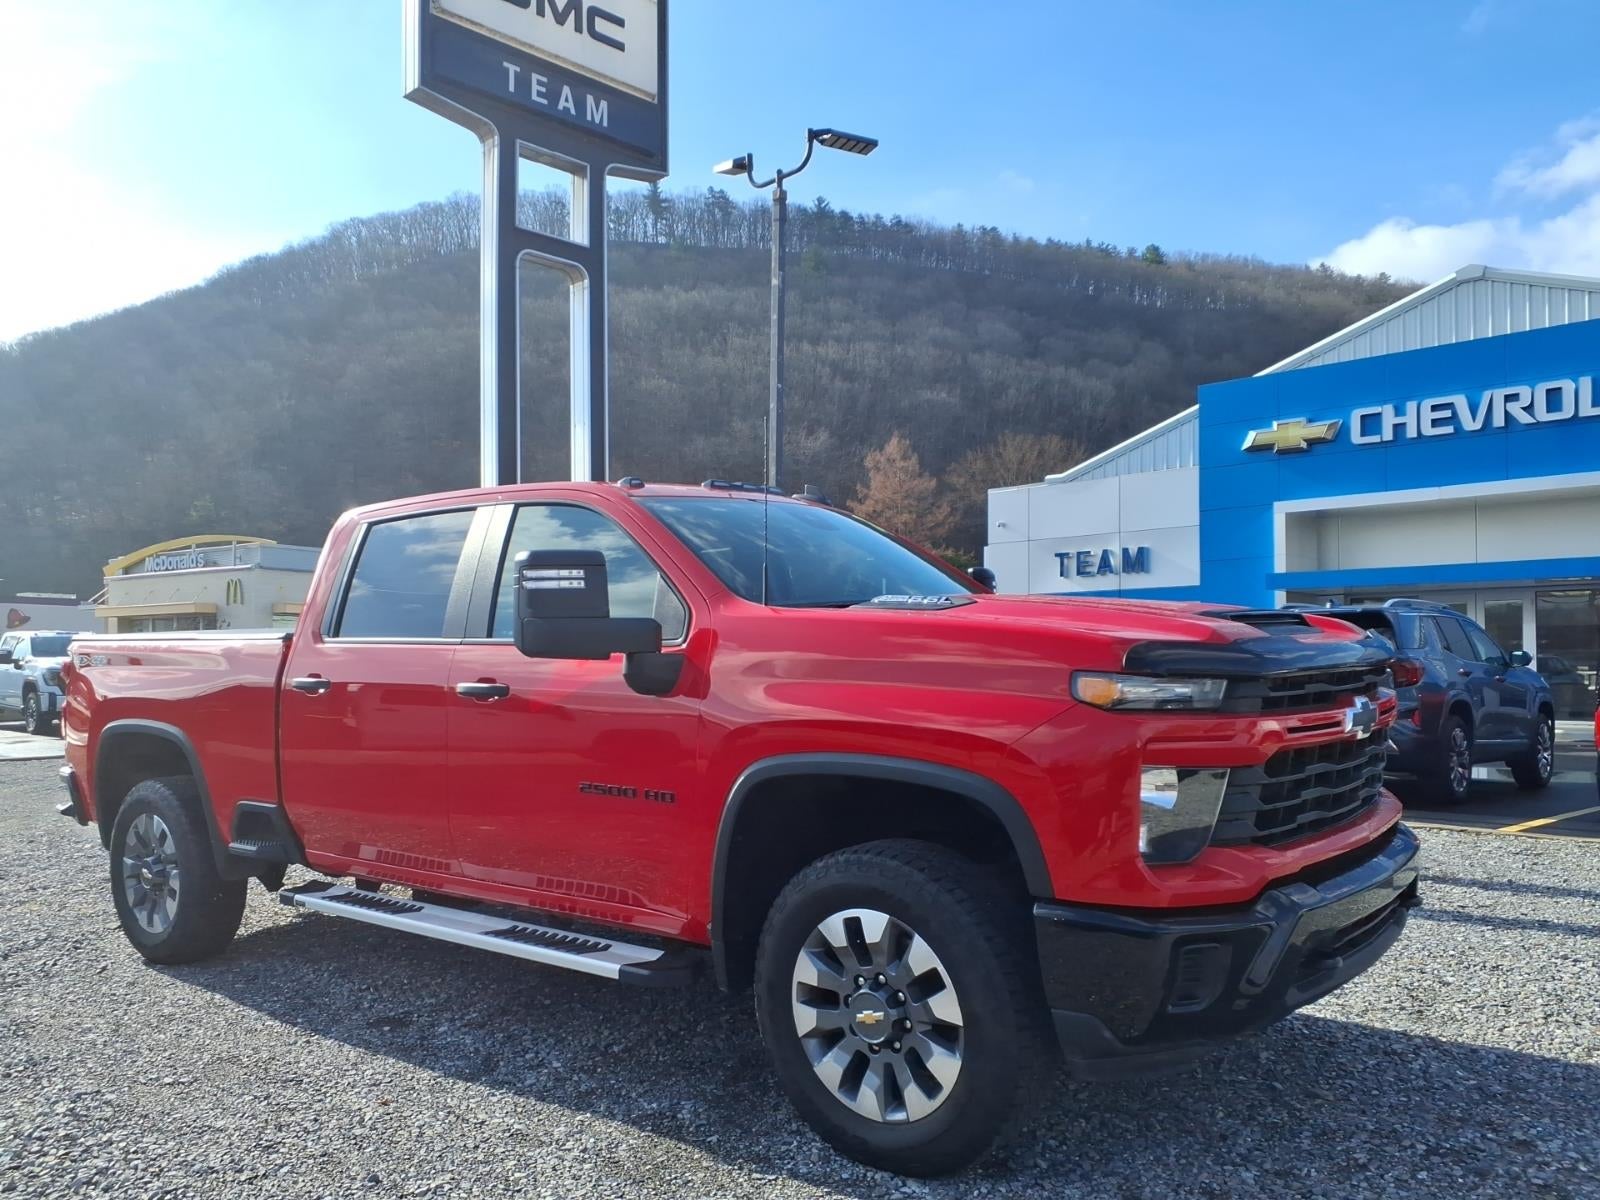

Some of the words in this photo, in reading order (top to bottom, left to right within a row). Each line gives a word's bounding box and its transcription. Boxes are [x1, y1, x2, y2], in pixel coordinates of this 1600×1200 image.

[502, 0, 625, 52] MC
[502, 61, 608, 127] TEAM
[144, 552, 205, 572] McDonald's
[1054, 546, 1151, 577] TEAM
[579, 781, 638, 799] 2500
[644, 788, 675, 803] HD
